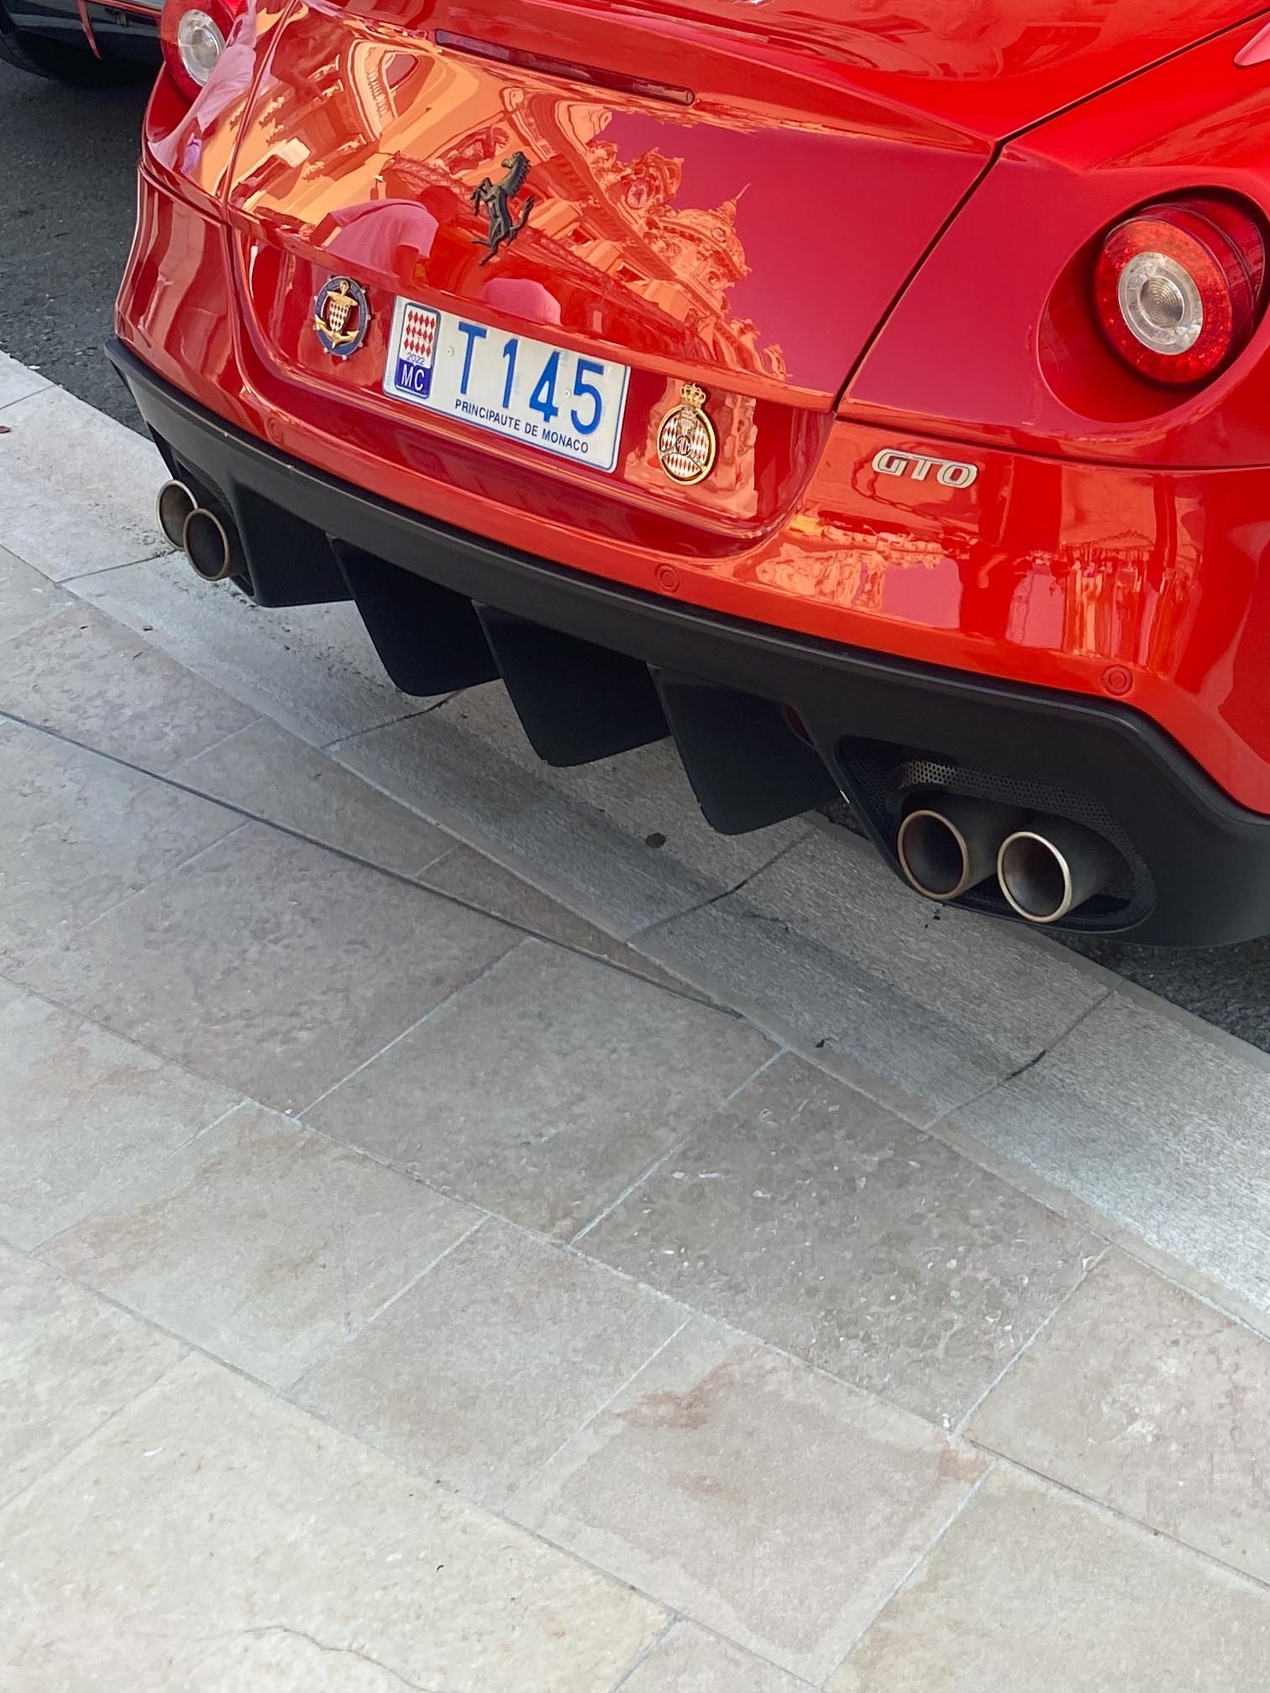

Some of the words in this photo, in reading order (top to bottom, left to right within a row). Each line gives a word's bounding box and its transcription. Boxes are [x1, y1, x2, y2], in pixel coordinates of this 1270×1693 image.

[401, 364, 425, 391] MC
[458, 321, 605, 435] T145
[455, 398, 520, 432] PRINCIPAUTE
[524, 422, 538, 437] DE
[541, 427, 589, 454] MONACO
[872, 448, 978, 489] GTO
